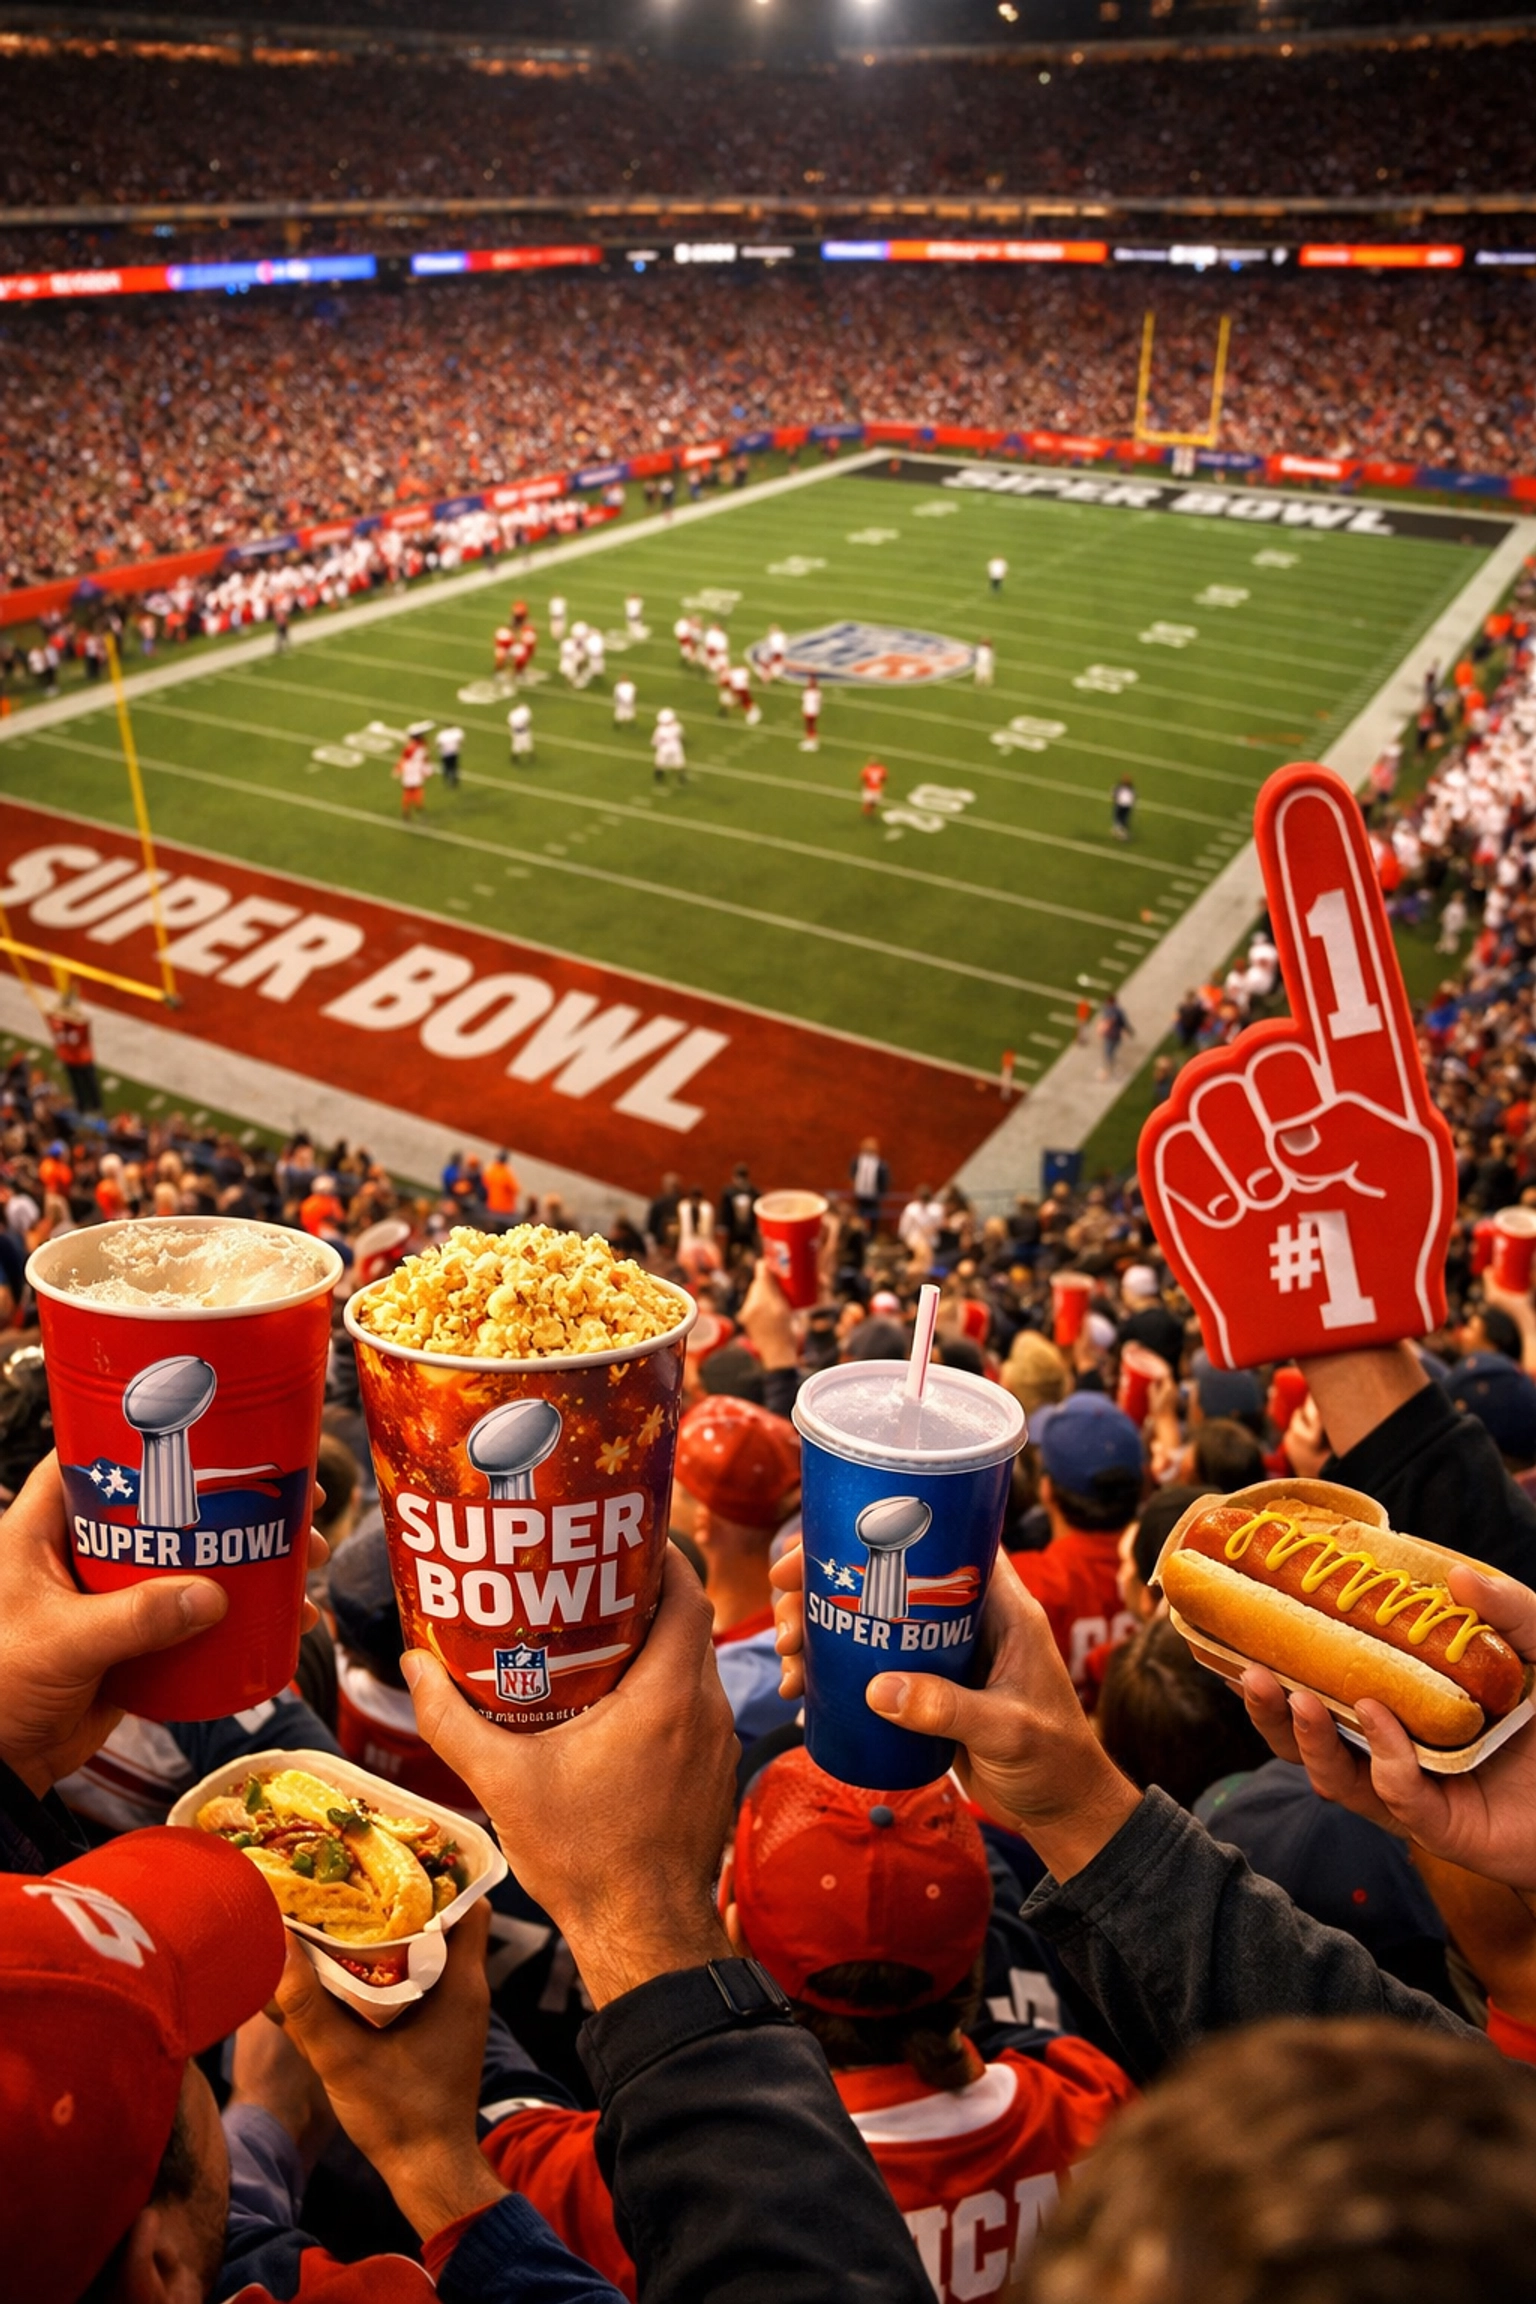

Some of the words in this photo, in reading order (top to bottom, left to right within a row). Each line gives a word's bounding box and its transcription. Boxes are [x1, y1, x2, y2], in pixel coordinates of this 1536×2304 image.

[1169, 487, 1395, 536] BOWL
[0, 845, 365, 1002] SUPER
[320, 944, 731, 1134] BOWL
[1305, 888, 1383, 1040] 1
[1268, 1210, 1378, 1331] #1
[74, 1515, 182, 1566] SUPER
[194, 1518, 291, 1567] BOWL
[396, 1491, 645, 1565] SUPER
[415, 1557, 636, 1627] BOWL
[808, 1591, 891, 1650] SUPER
[900, 1614, 974, 1651] BOWL
